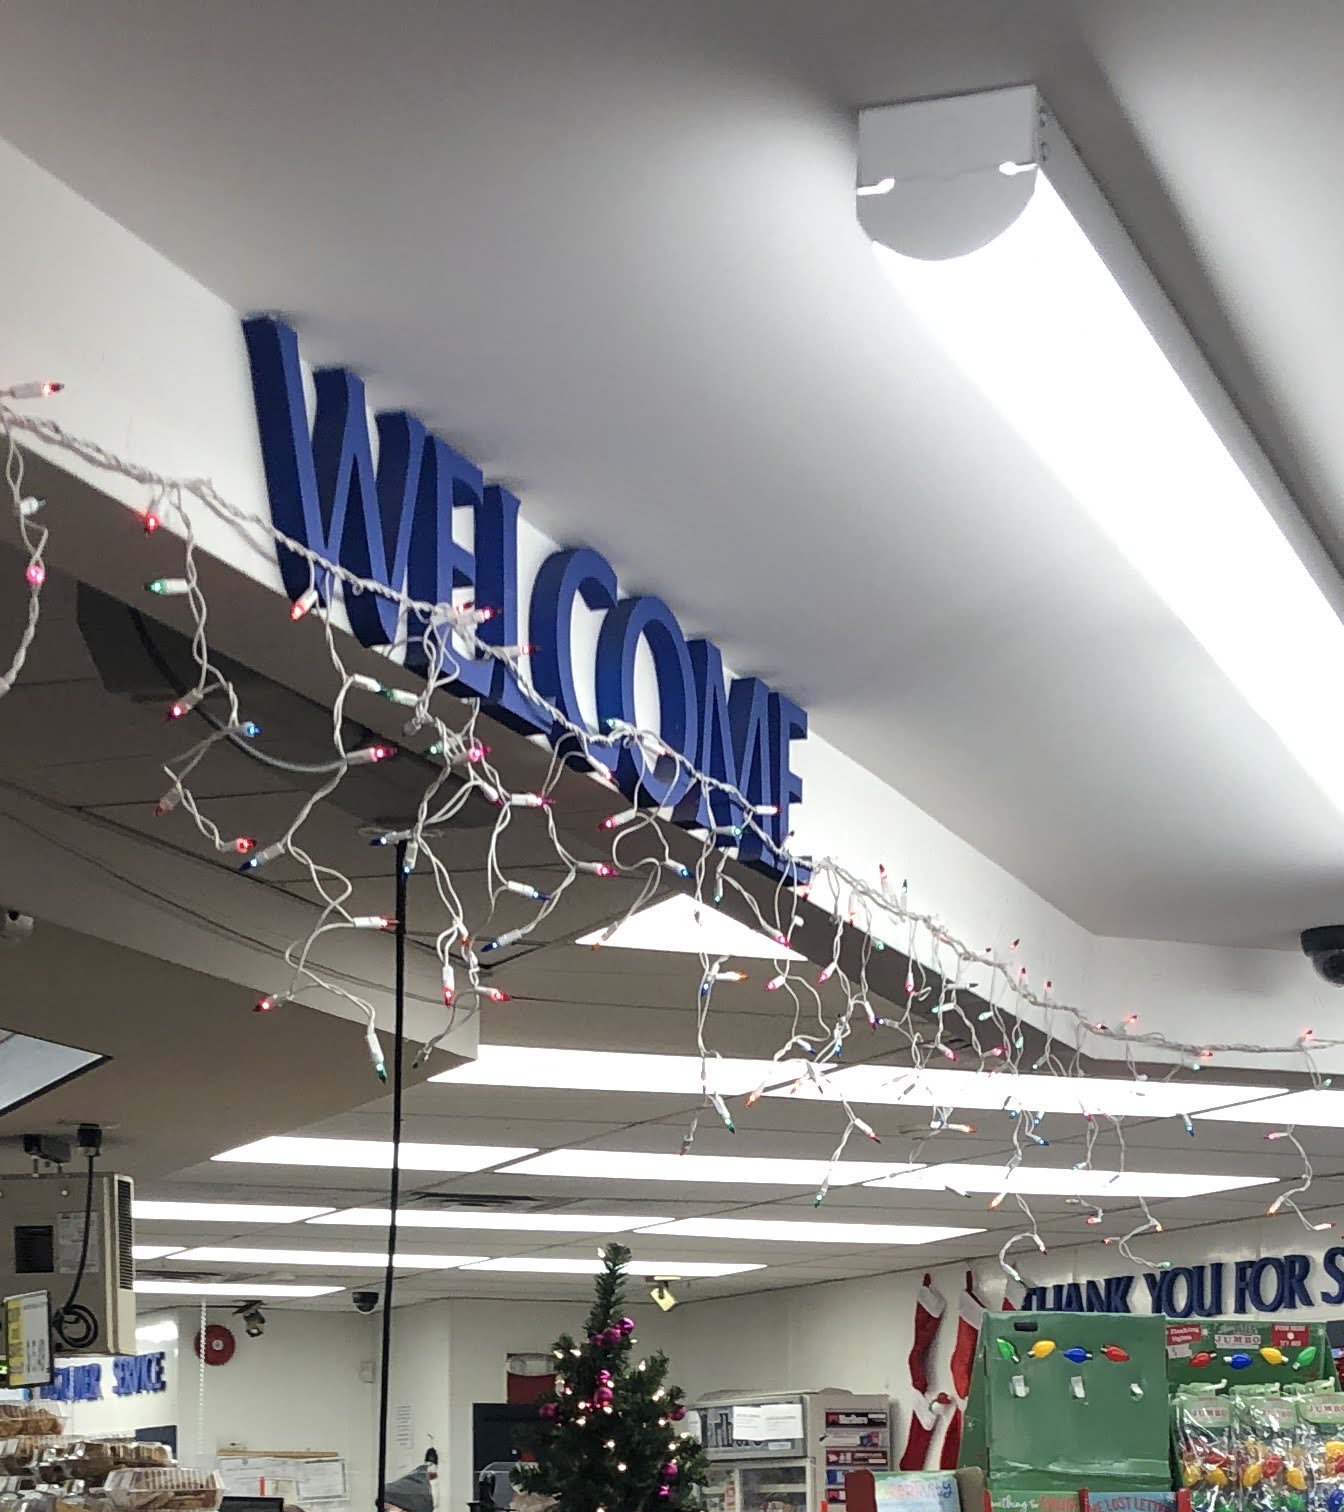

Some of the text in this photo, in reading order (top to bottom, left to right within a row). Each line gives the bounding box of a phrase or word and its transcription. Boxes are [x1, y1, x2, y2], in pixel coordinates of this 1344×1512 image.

[243, 315, 812, 885] WELCOME
[1021, 1276, 1134, 1313] THANK
[1143, 1262, 1224, 1319] YOU
[1235, 1254, 1315, 1314] FOR
[1215, 1335, 1261, 1344] JUMBO
